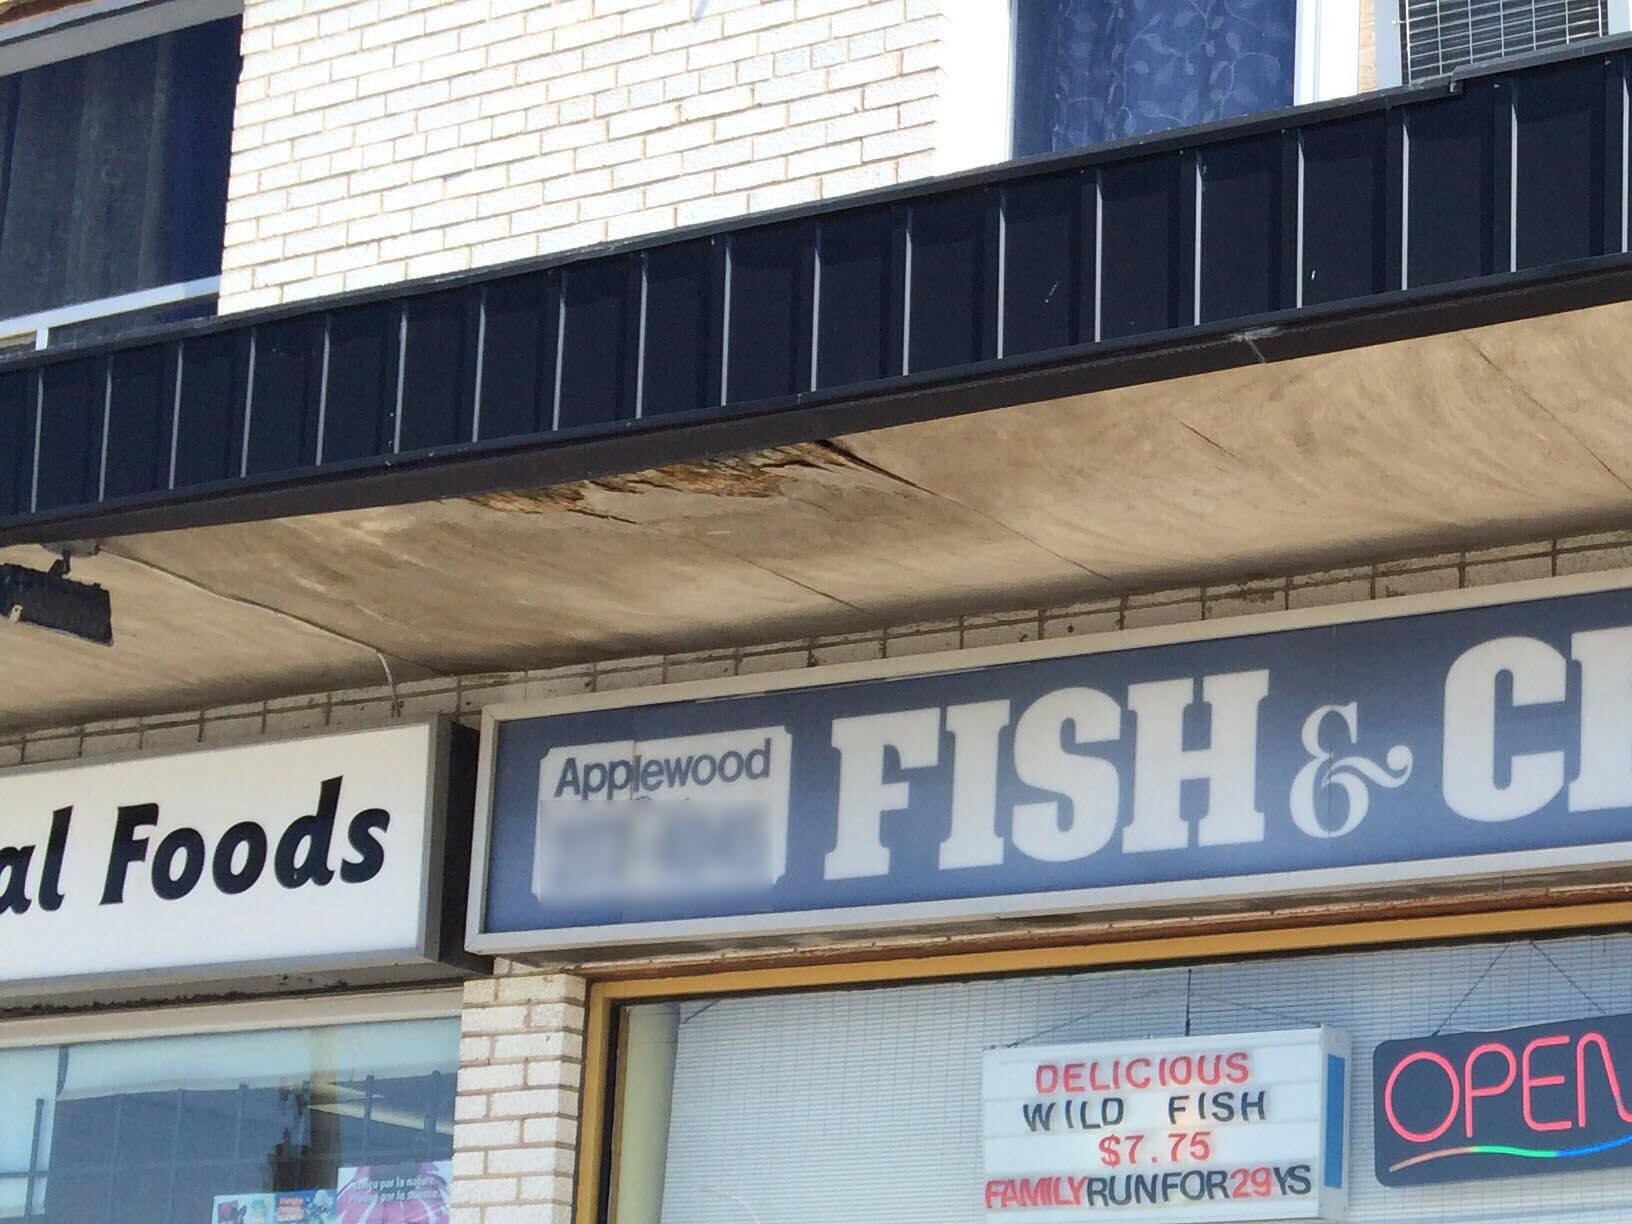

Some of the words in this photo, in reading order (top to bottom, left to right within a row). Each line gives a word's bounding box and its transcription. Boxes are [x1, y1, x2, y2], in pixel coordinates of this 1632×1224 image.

[554, 737, 771, 800] Applewood
[824, 669, 1270, 881] FISH
[1290, 703, 1413, 843] &
[99, 774, 391, 907] Foods
[1035, 1051, 1250, 1095] DELICIOUS
[1022, 1096, 1125, 1133] WILD
[1168, 1090, 1267, 1126] FISH
[1098, 1130, 1213, 1168] $7.75
